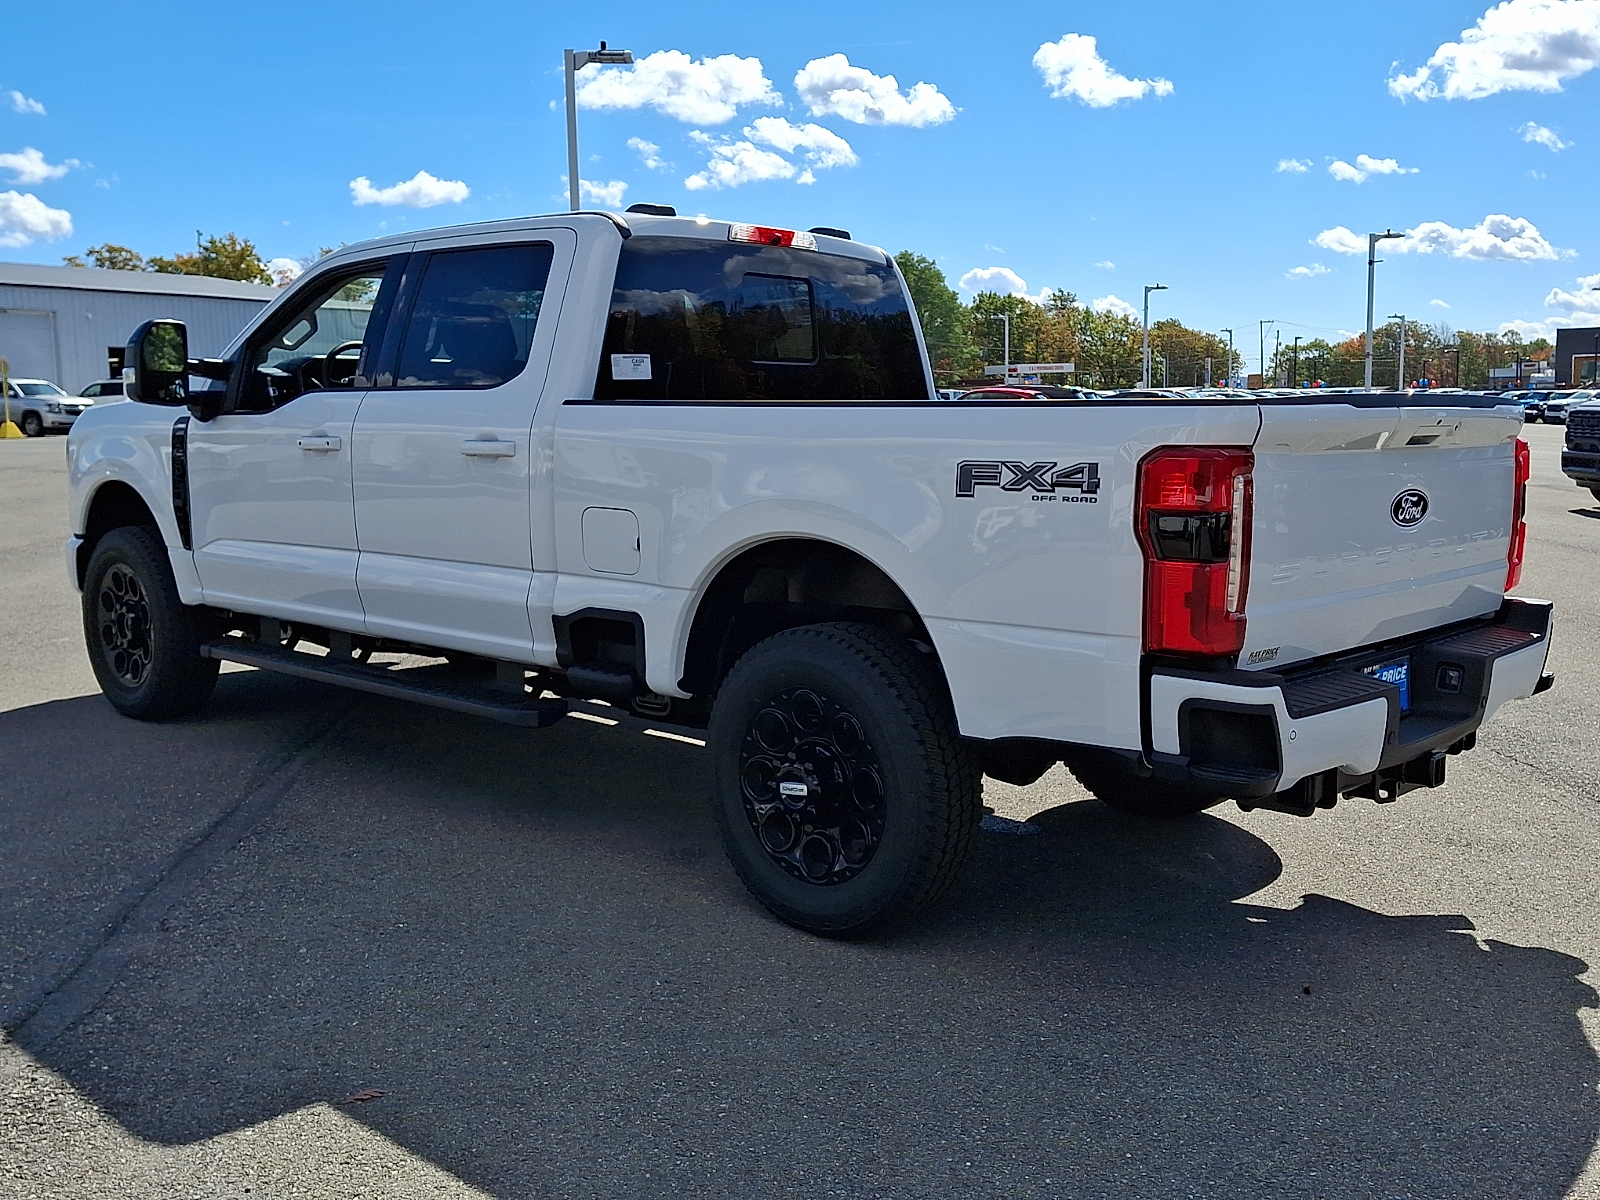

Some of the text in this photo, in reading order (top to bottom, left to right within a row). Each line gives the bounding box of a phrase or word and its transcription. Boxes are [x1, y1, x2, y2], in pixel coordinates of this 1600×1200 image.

[955, 460, 1101, 498] FX4
[1061, 496, 1098, 504] ROAD
[1398, 495, 1424, 520] Ford
[1271, 528, 1505, 585] SUPER DUTY
[1382, 664, 1407, 682] PRICE
